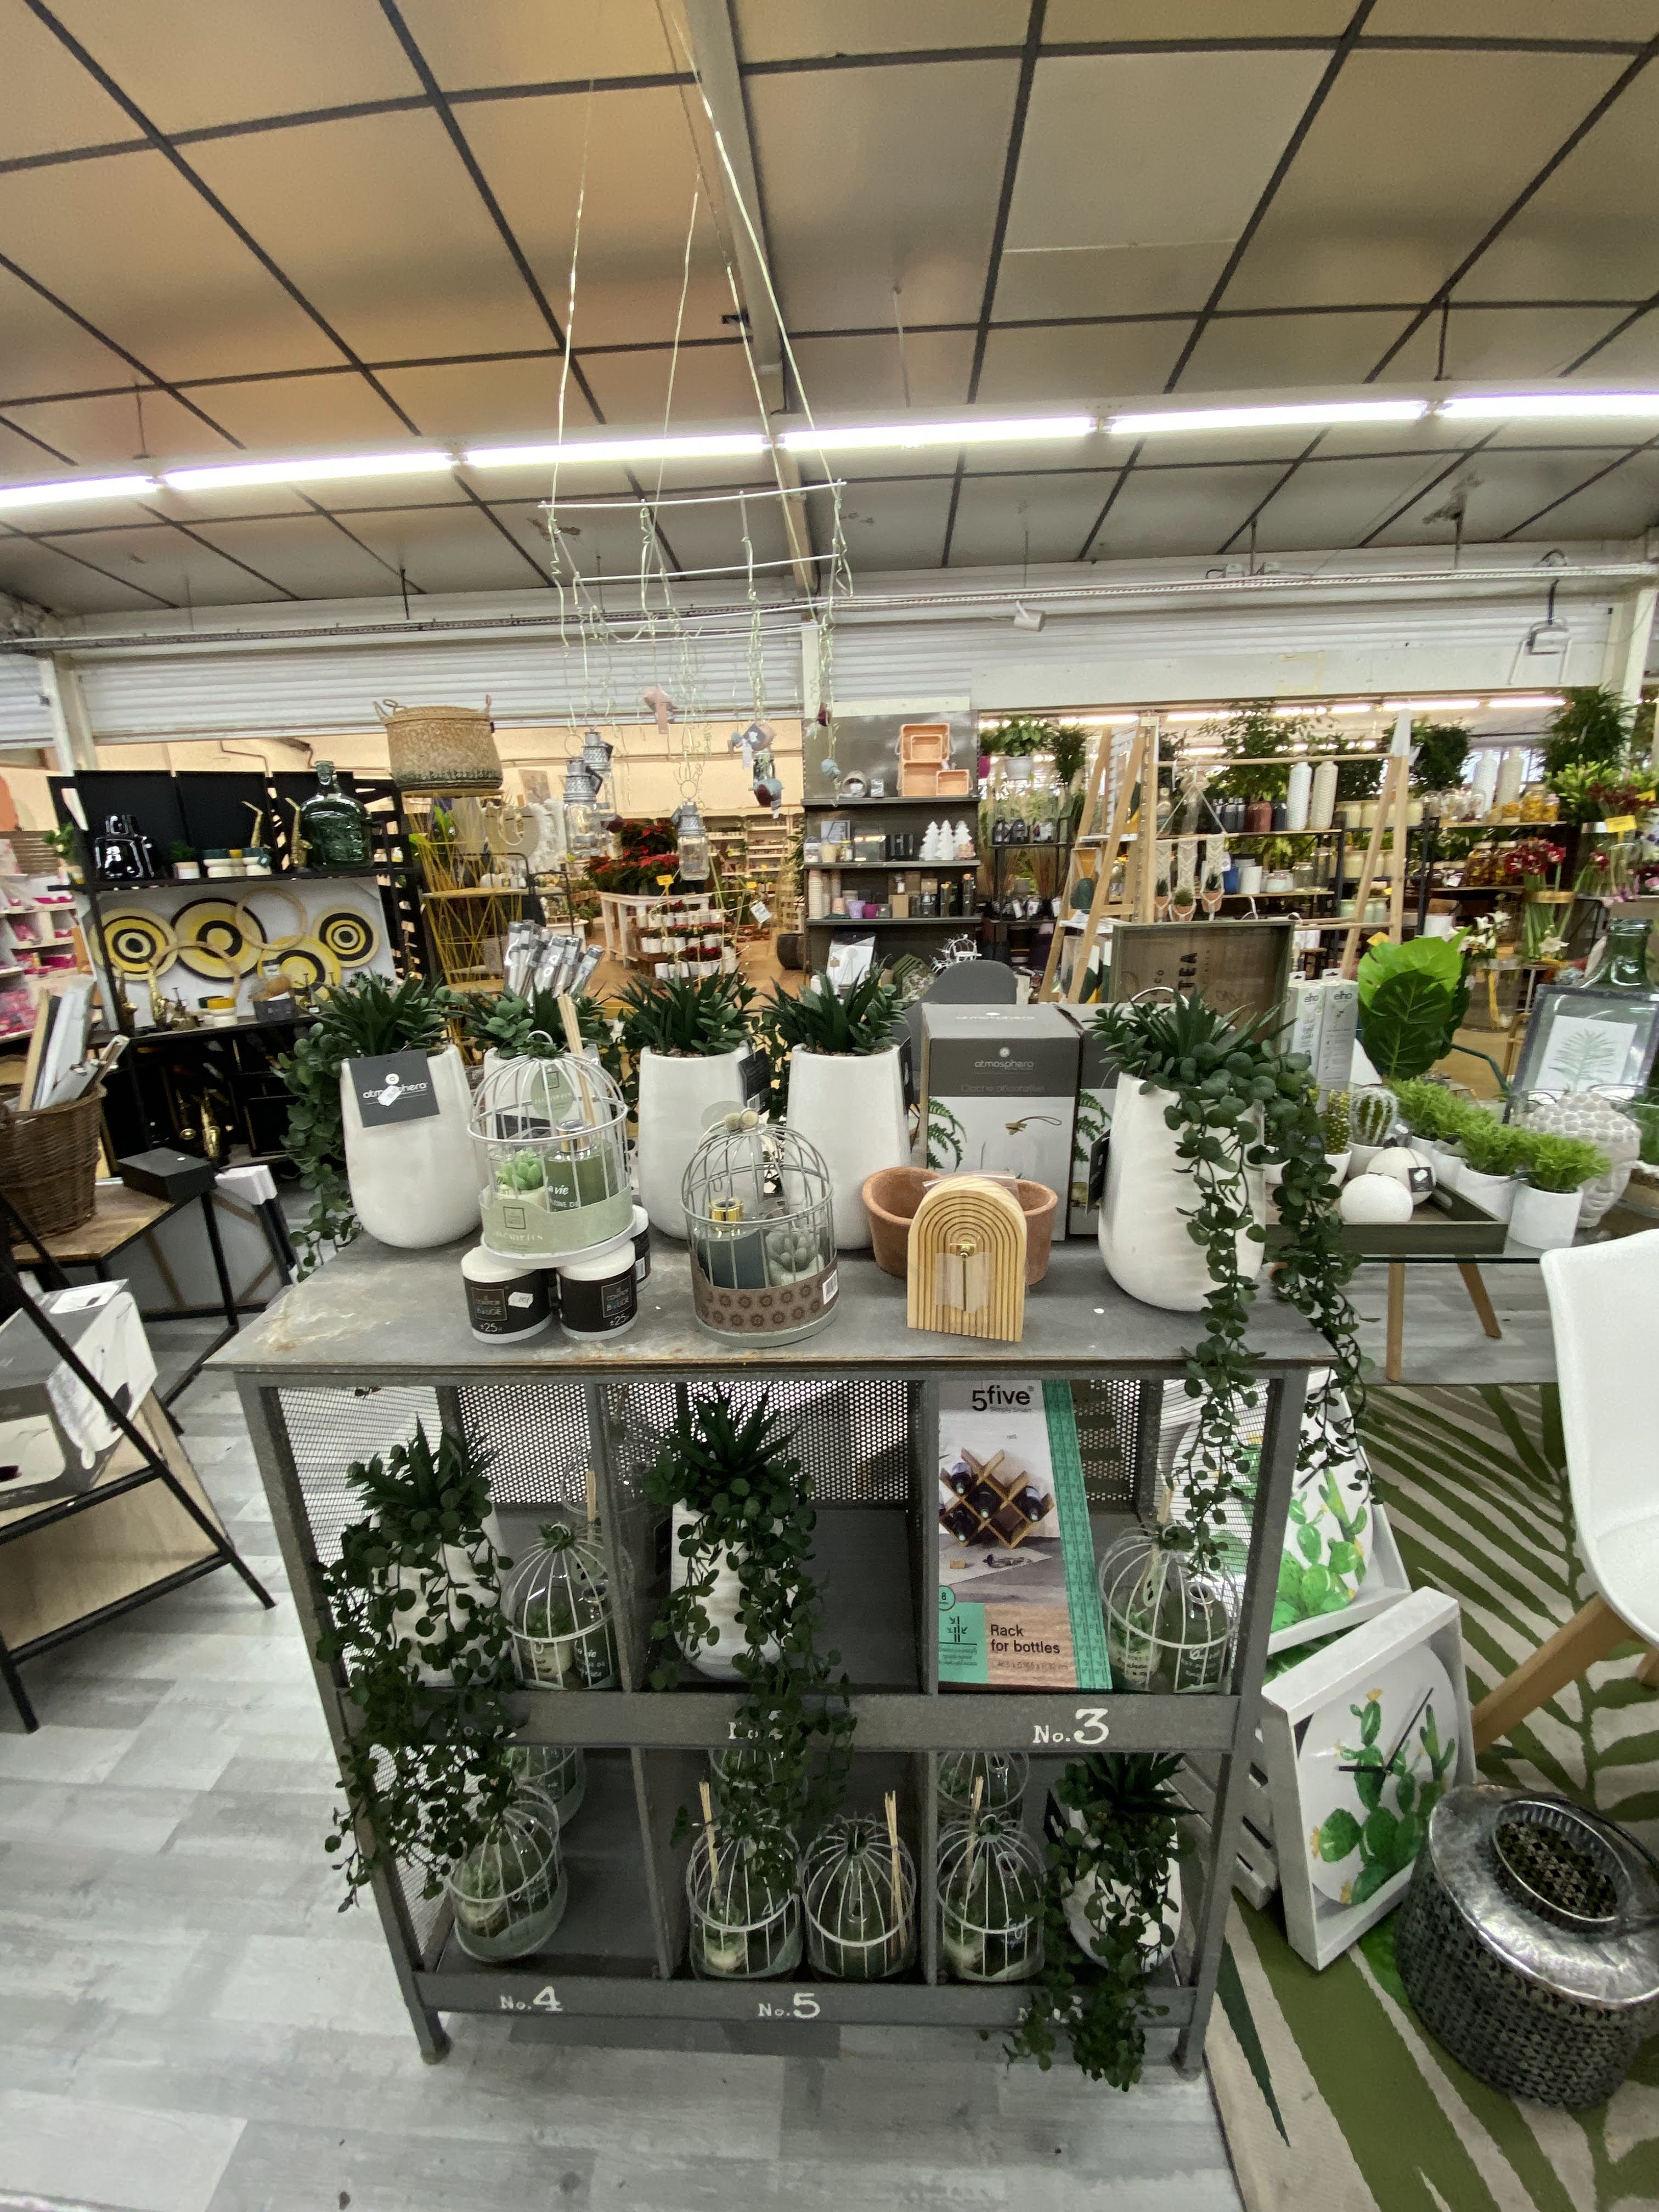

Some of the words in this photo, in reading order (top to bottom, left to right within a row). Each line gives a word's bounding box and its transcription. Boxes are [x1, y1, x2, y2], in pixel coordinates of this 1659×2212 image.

[1178, 952, 1198, 991] TEA
[363, 1082, 428, 1099] atmhera
[554, 1184, 569, 1195] vie
[941, 1592, 947, 1601] 8
[990, 1624, 1024, 1637] Rack
[991, 1639, 1009, 1652] for
[1013, 1640, 1061, 1654] bottles
[1032, 1708, 1110, 1746] No.3
[500, 1985, 564, 2012] No.4
[758, 1992, 820, 2019] No.5
